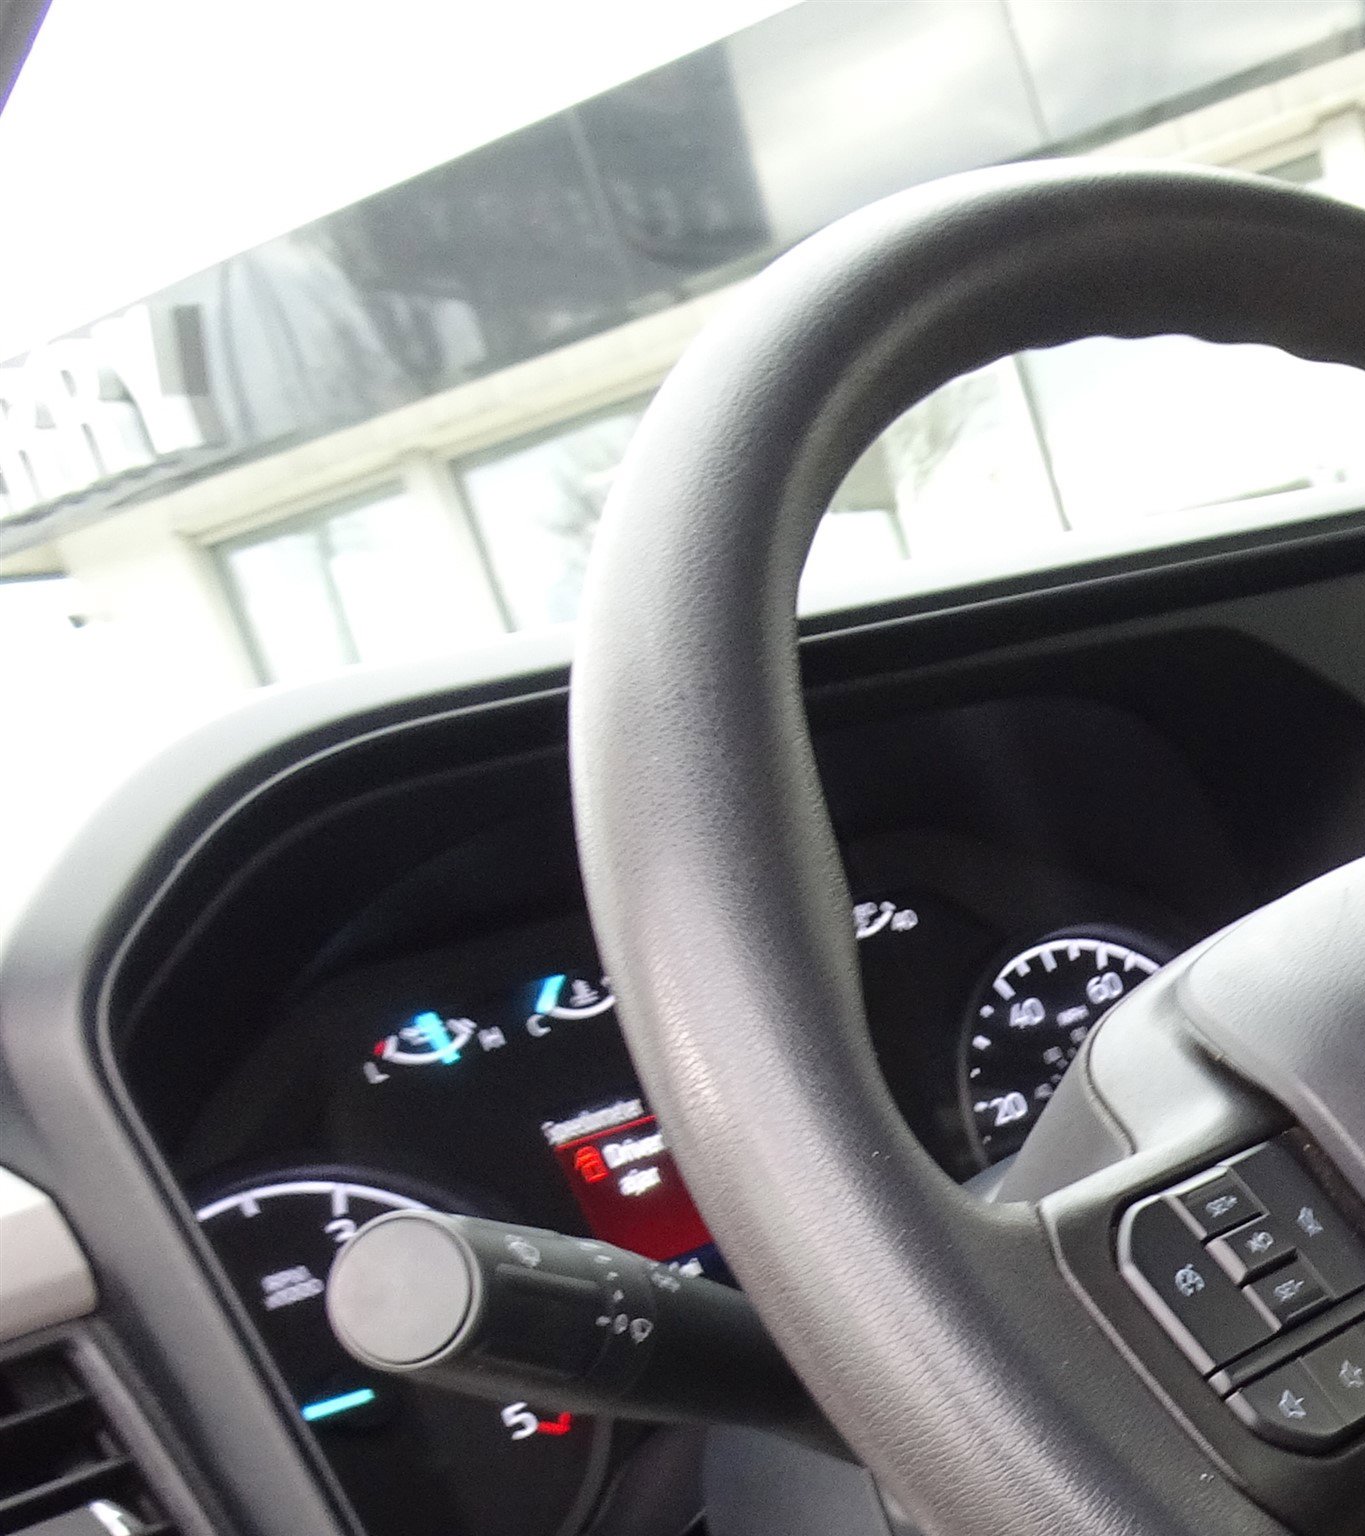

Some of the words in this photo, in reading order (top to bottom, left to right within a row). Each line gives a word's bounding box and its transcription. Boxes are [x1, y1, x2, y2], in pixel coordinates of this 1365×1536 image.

[1086, 972, 1124, 1005] 60
[1009, 997, 1046, 1029] 40
[988, 1091, 1029, 1127] 20
[500, 1401, 538, 1440] 5
